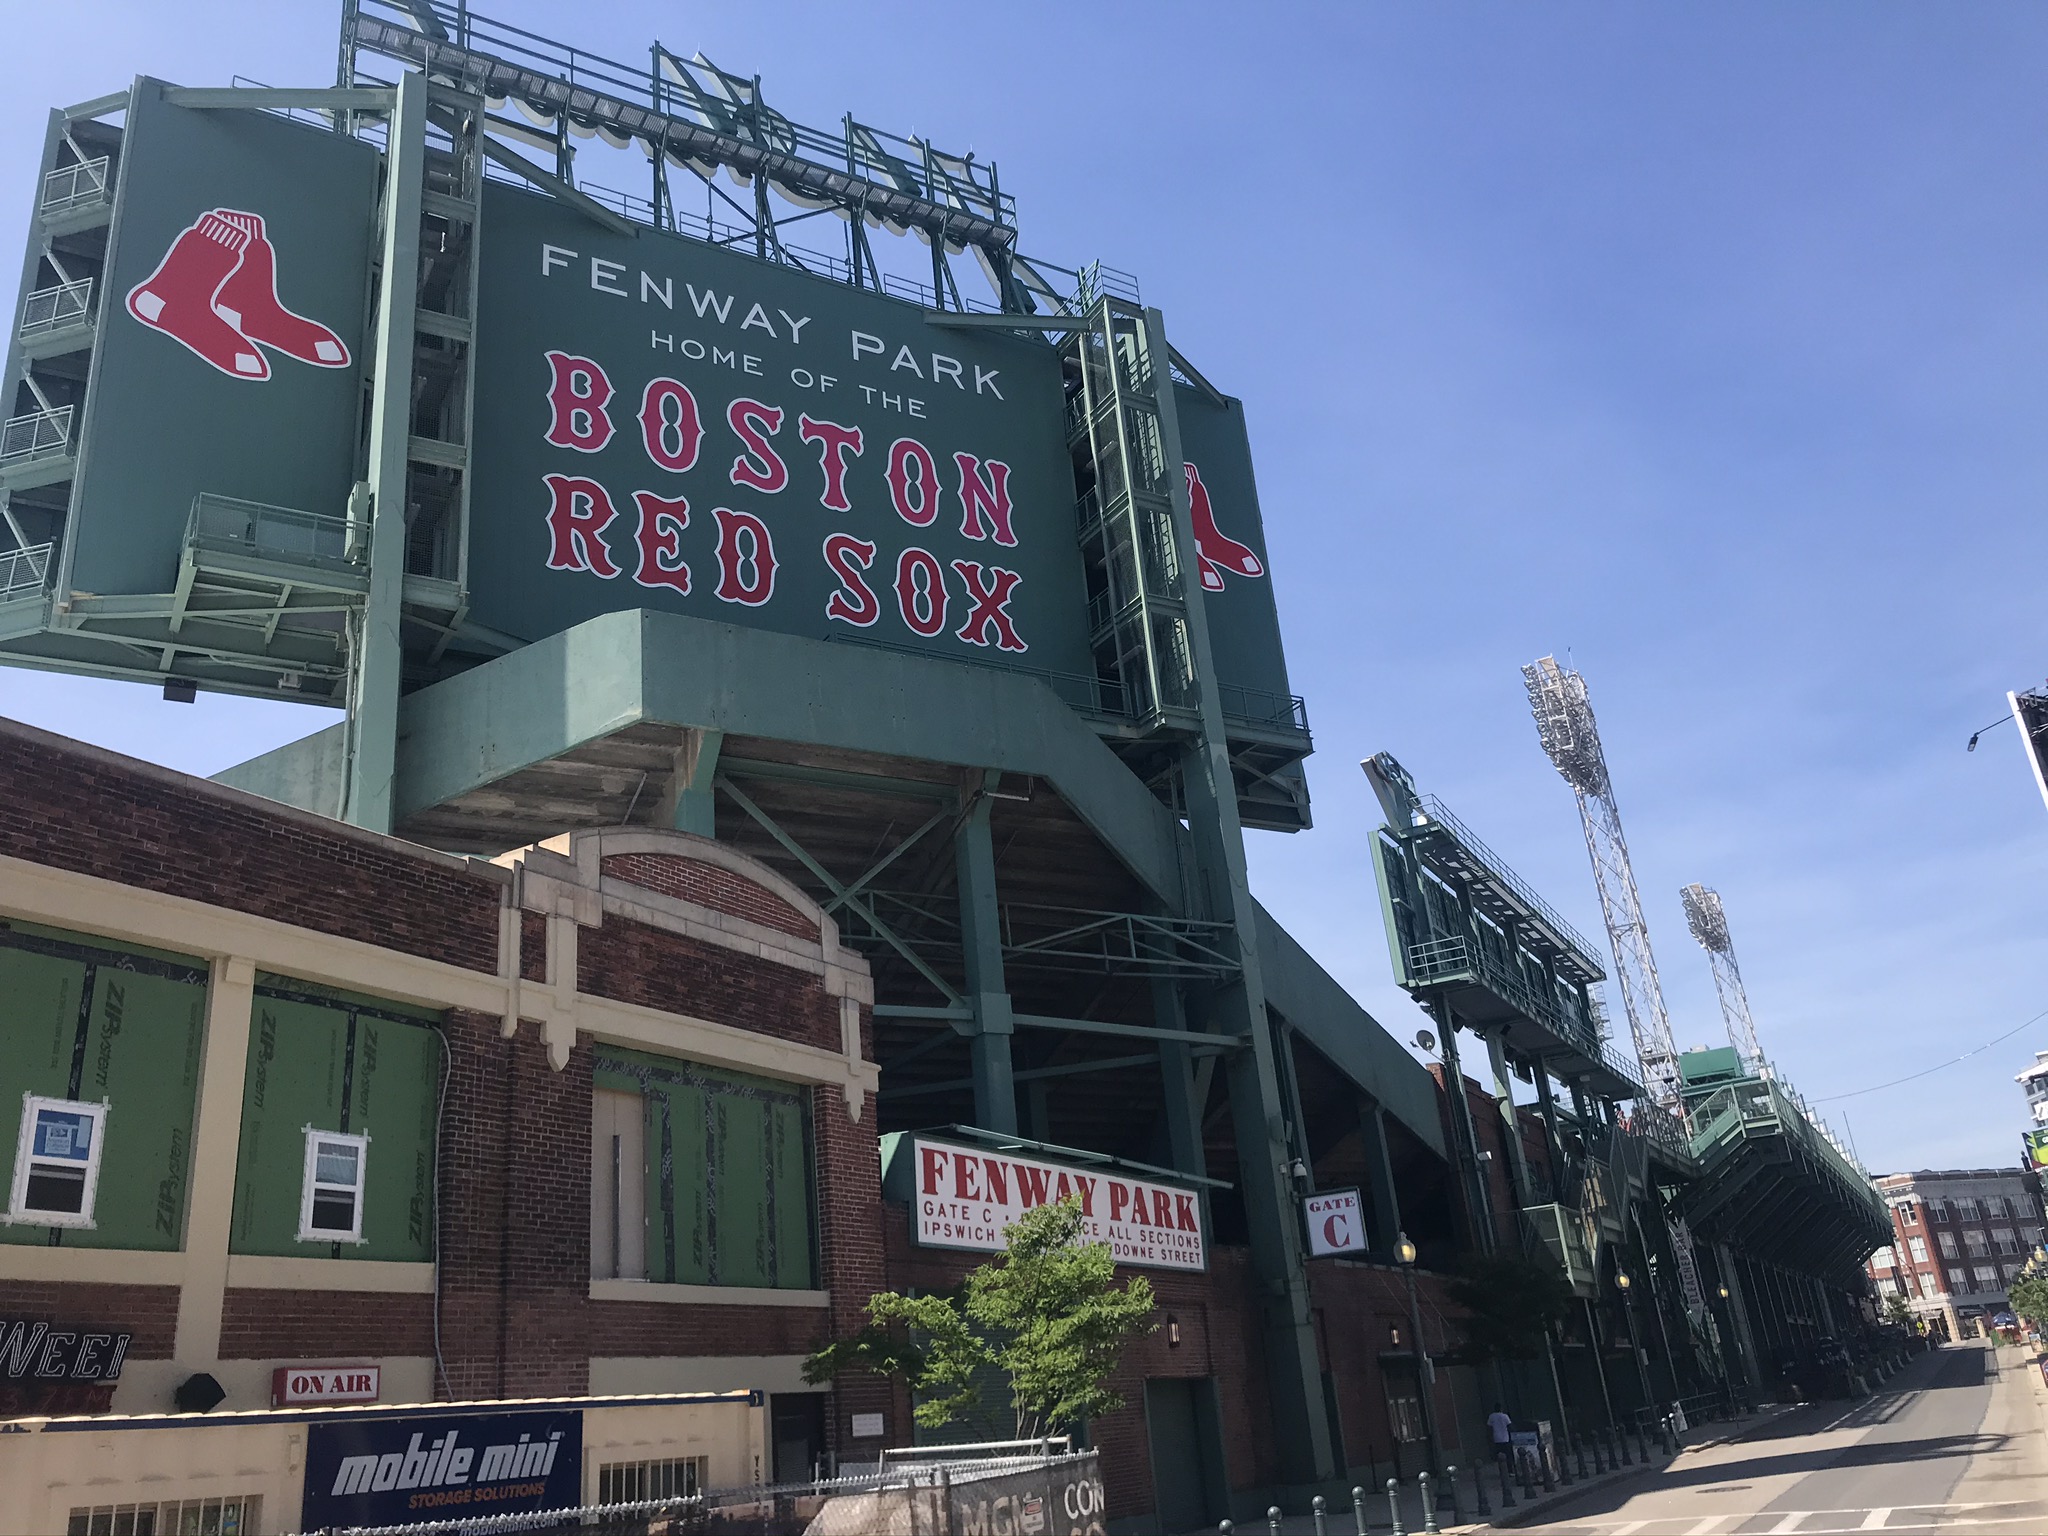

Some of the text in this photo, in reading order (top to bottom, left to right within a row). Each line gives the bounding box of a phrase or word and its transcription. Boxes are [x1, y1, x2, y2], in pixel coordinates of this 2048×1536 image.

[541, 243, 1005, 401] FENWAY PARK
[650, 329, 928, 420] HOME OF THE
[543, 349, 1021, 548] BOSTON
[541, 472, 1029, 654] RED SOX
[920, 1147, 1097, 1217] FENWAY
[1108, 1181, 1198, 1232] PARK
[1309, 1197, 1355, 1212] GATE
[923, 1200, 992, 1223] GATE C
[924, 1221, 995, 1242] IPSWICH
[1323, 1214, 1350, 1248] C
[1108, 1225, 1200, 1249] ALL SECTIONS
[1161, 1249, 1201, 1265] STREET
[1681, 1255, 1700, 1305] BLEACHER
[0, 1321, 131, 1378] WEEI
[291, 1375, 372, 1394] ON AIR
[331, 1430, 562, 1496] mobile mini
[408, 1482, 546, 1509] STORAGE SOLUTIONS
